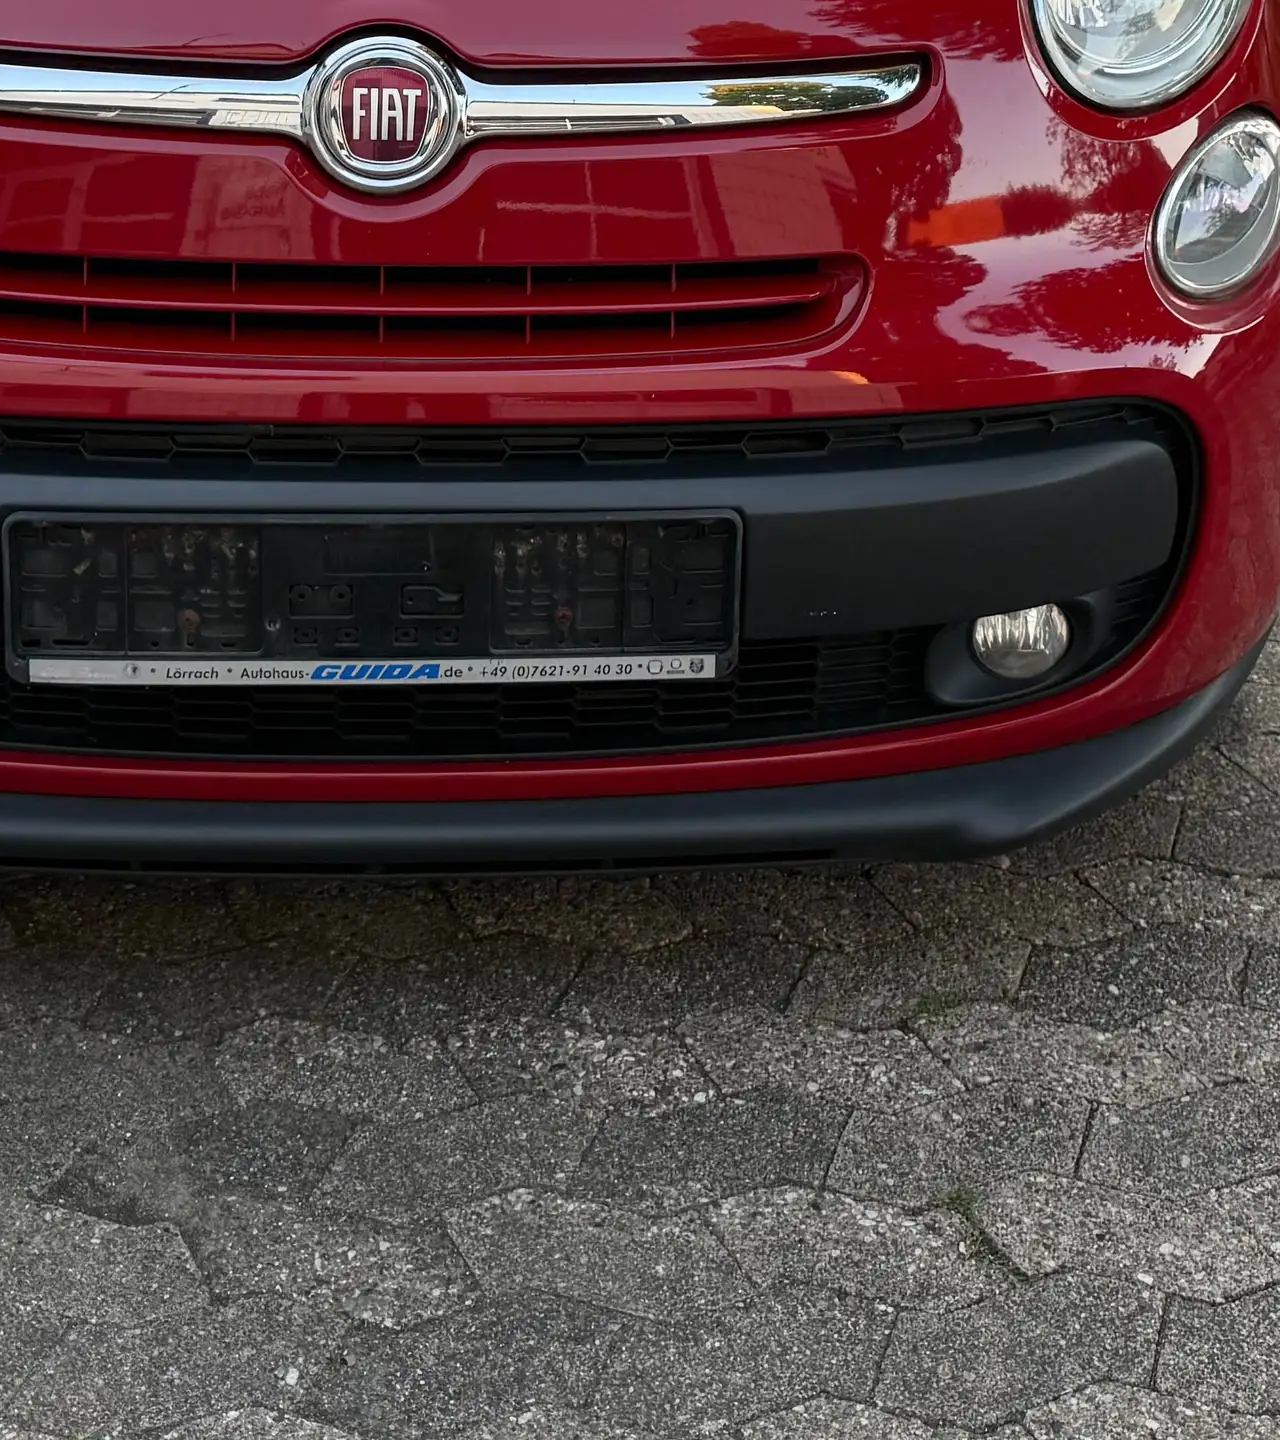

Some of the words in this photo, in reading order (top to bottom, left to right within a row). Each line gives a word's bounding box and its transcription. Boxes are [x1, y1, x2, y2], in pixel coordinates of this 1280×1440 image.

[352, 87, 422, 141] FIAT
[165, 666, 219, 680] Lörrach
[480, 665, 507, 678] +49
[594, 664, 611, 676] 40
[615, 663, 632, 675] 30
